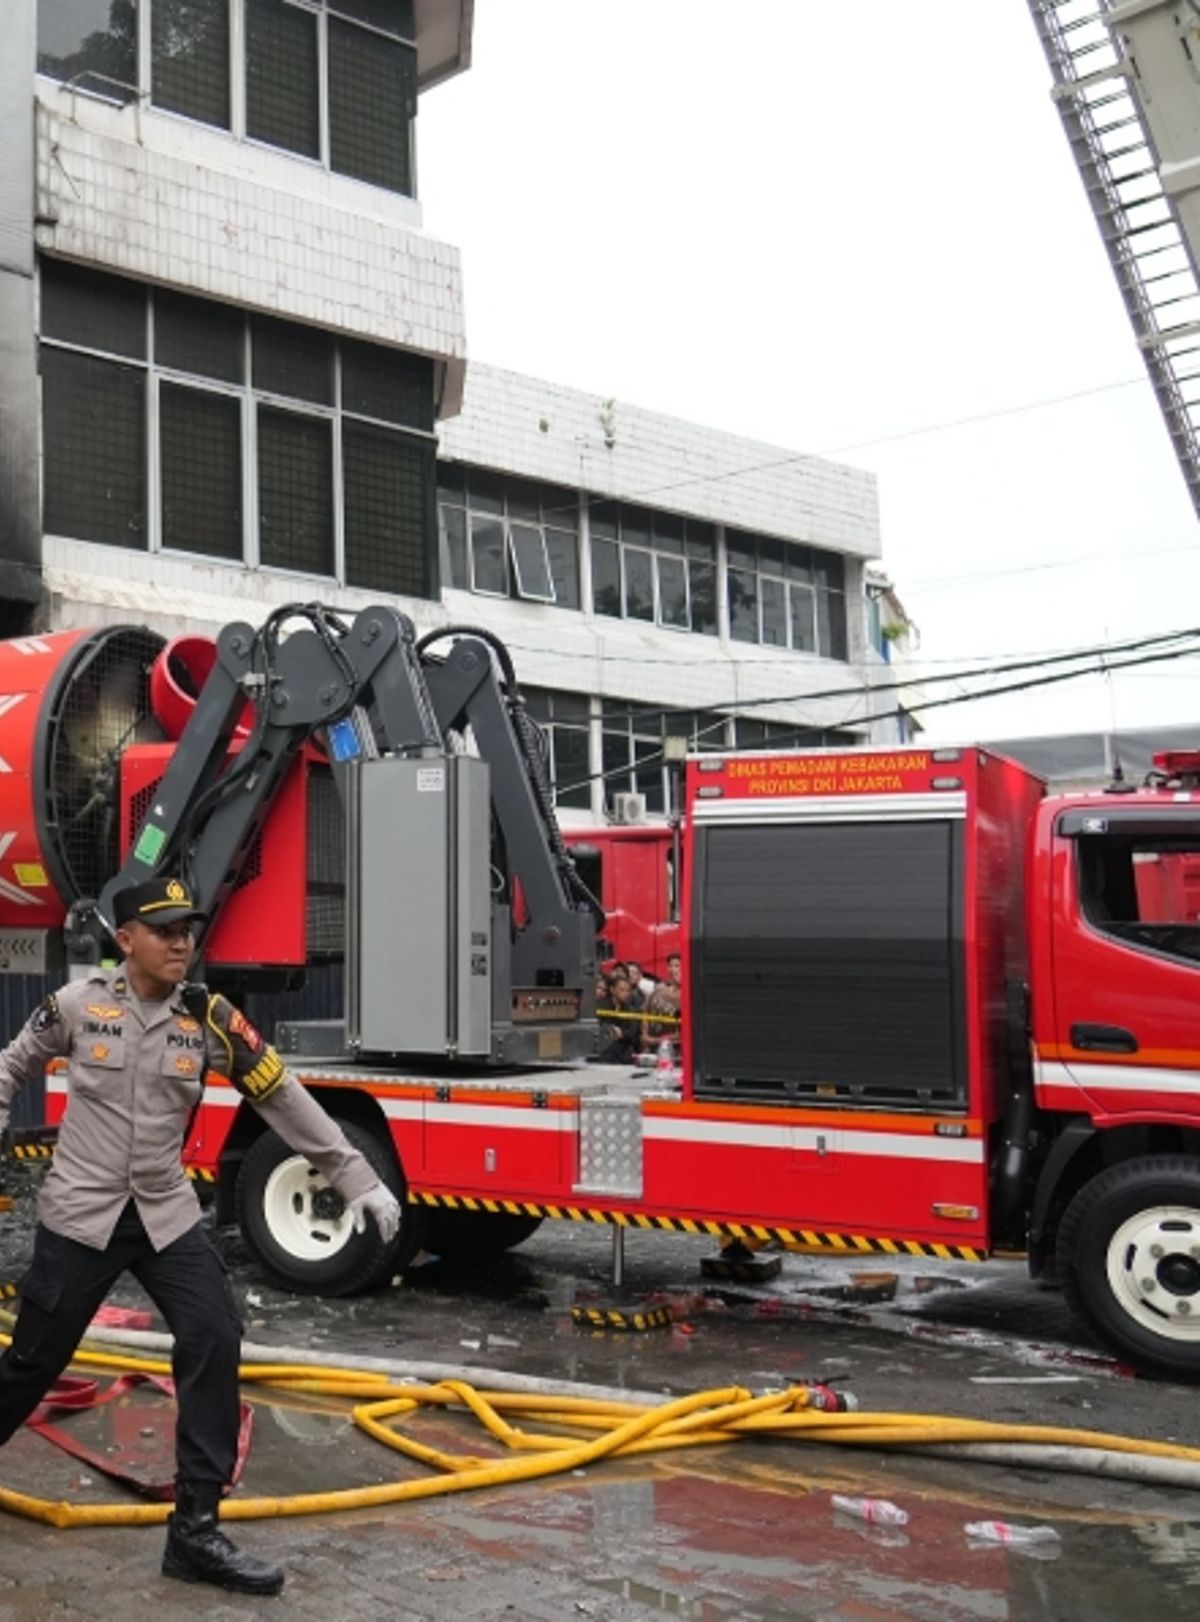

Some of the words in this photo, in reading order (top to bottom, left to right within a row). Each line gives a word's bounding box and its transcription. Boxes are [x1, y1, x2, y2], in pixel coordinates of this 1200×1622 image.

[728, 762, 767, 777] DINAS
[841, 755, 928, 773] KEBAKARAN
[749, 779, 809, 795] PROVINSI
[813, 777, 836, 792] DKI
[839, 775, 902, 792] JAKARTA
[82, 1020, 123, 1038] IMAM
